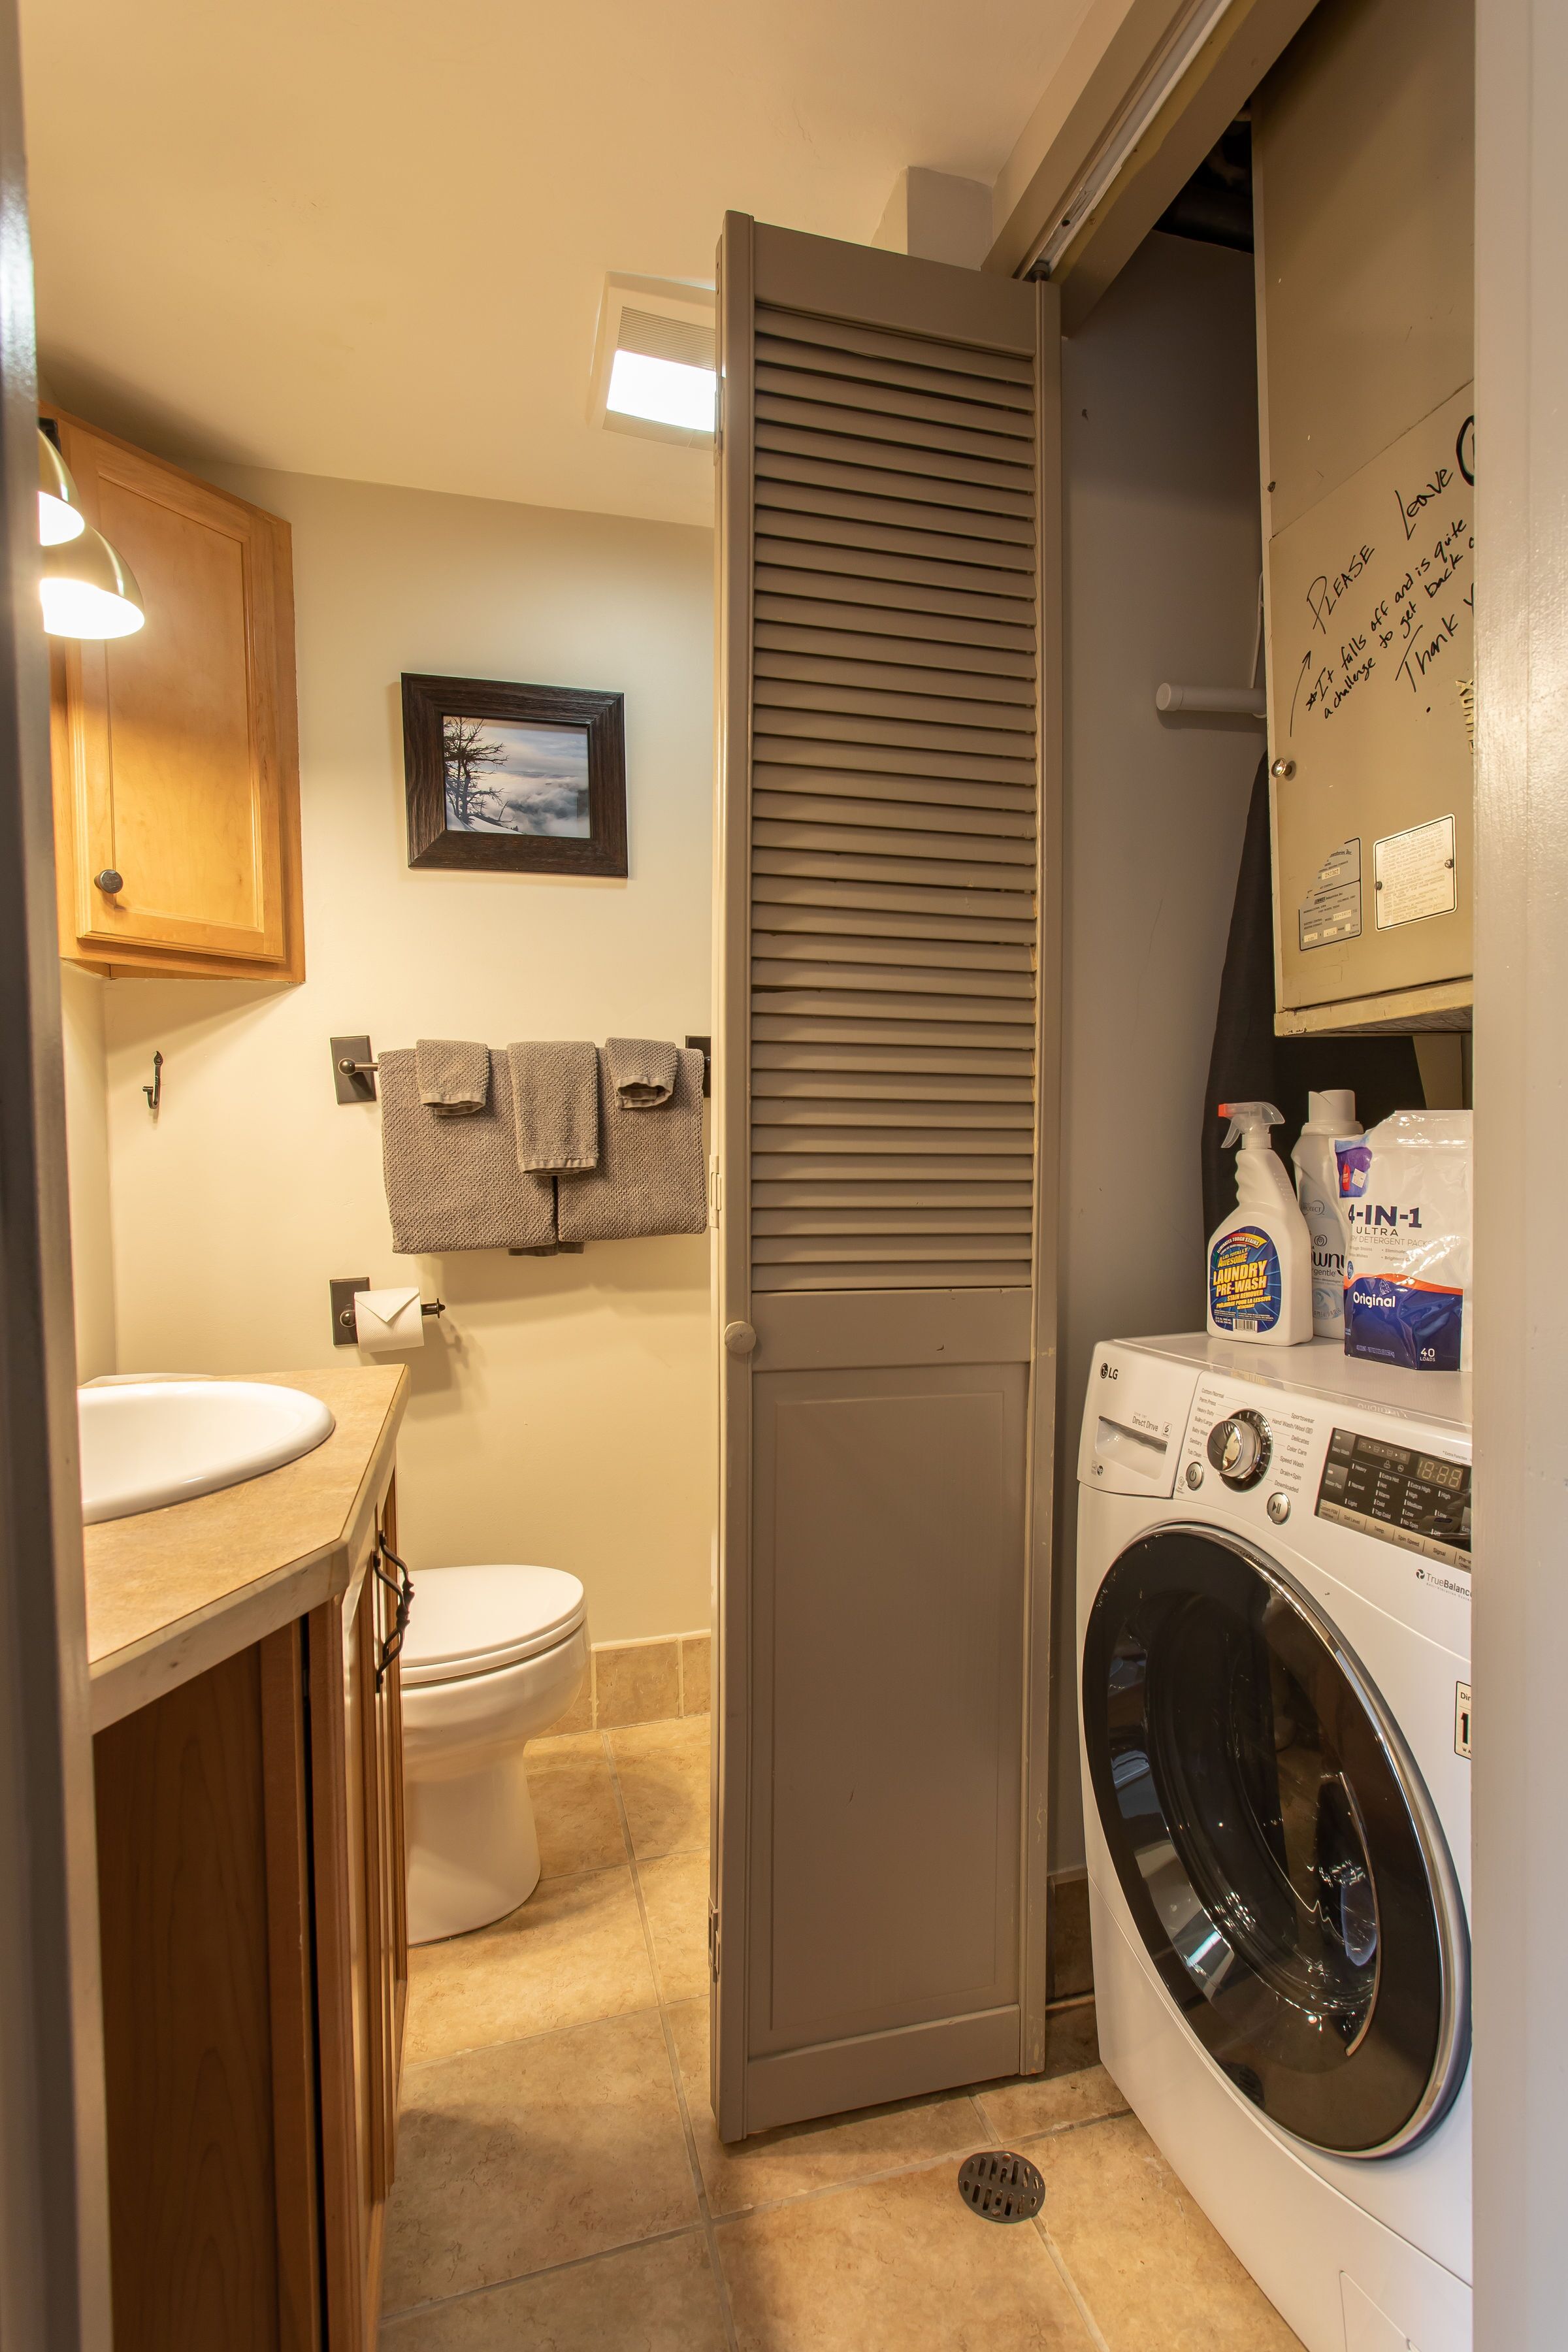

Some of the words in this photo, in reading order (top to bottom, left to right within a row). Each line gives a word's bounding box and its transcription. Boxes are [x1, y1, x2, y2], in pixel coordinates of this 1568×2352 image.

[1307, 544, 1375, 634] PLEASE
[1395, 468, 1454, 540] Leave
[1341, 634, 1367, 670] falls
[1371, 600, 1389, 631] off
[1395, 573, 1413, 603] and
[1415, 558, 1430, 576] is
[1434, 519, 1467, 563] quite
[1334, 658, 1376, 708] challenge
[1379, 631, 1393, 648] to
[1400, 600, 1416, 639] get
[1424, 553, 1463, 598] back
[1395, 613, 1458, 693] Thank
[1348, 1204, 1422, 1228] 4-IN-1
[1356, 1226, 1398, 1236] ULTRA
[1359, 1235, 1405, 1245] DETERGENT
[1218, 1252, 1249, 1268] AWESOME
[1213, 1260, 1268, 1286] LAUNDRY
[1313, 1269, 1336, 1277] gentle
[1216, 1275, 1267, 1298] PRE-WASH
[1352, 1290, 1396, 1309] Original
[1420, 1348, 1435, 1357] 40
[1108, 1367, 1119, 1380] LG
[1132, 1416, 1146, 1428] Direct
[1146, 1420, 1158, 1431] Drive
[1291, 1413, 1315, 1424] Sportswear
[1282, 1420, 1305, 1432] Wash/Wool
[1189, 1437, 1202, 1446] Sanitary
[1291, 1435, 1309, 1445] Delicates
[1286, 1445, 1297, 1453] Color
[1298, 1448, 1307, 1456] Care
[1280, 1456, 1292, 1465] Speed
[1293, 1460, 1304, 1469] Wash
[1280, 1468, 1301, 1480] Drain+Spin
[1354, 1464, 1367, 1473] Heavy
[1274, 1480, 1299, 1493] Downloaded
[1350, 1481, 1365, 1491] Normal
[1410, 1482, 1421, 1491] Extra
[1378, 1490, 1390, 1499] Warm
[1408, 1490, 1418, 1499] High
[1441, 1492, 1451, 1500] High
[1348, 1499, 1358, 1508] Light
[1407, 1500, 1423, 1511] Medium
[1382, 1511, 1391, 1520] Cold
[1437, 1511, 1447, 1519] Low
[1409, 1521, 1418, 1529] Spin
[1397, 1534, 1407, 1543] Spin
[1407, 1538, 1420, 1547] Speed
[1433, 1547, 1446, 1557] Signal
[1426, 1572, 1472, 1597] TrueBalanc
